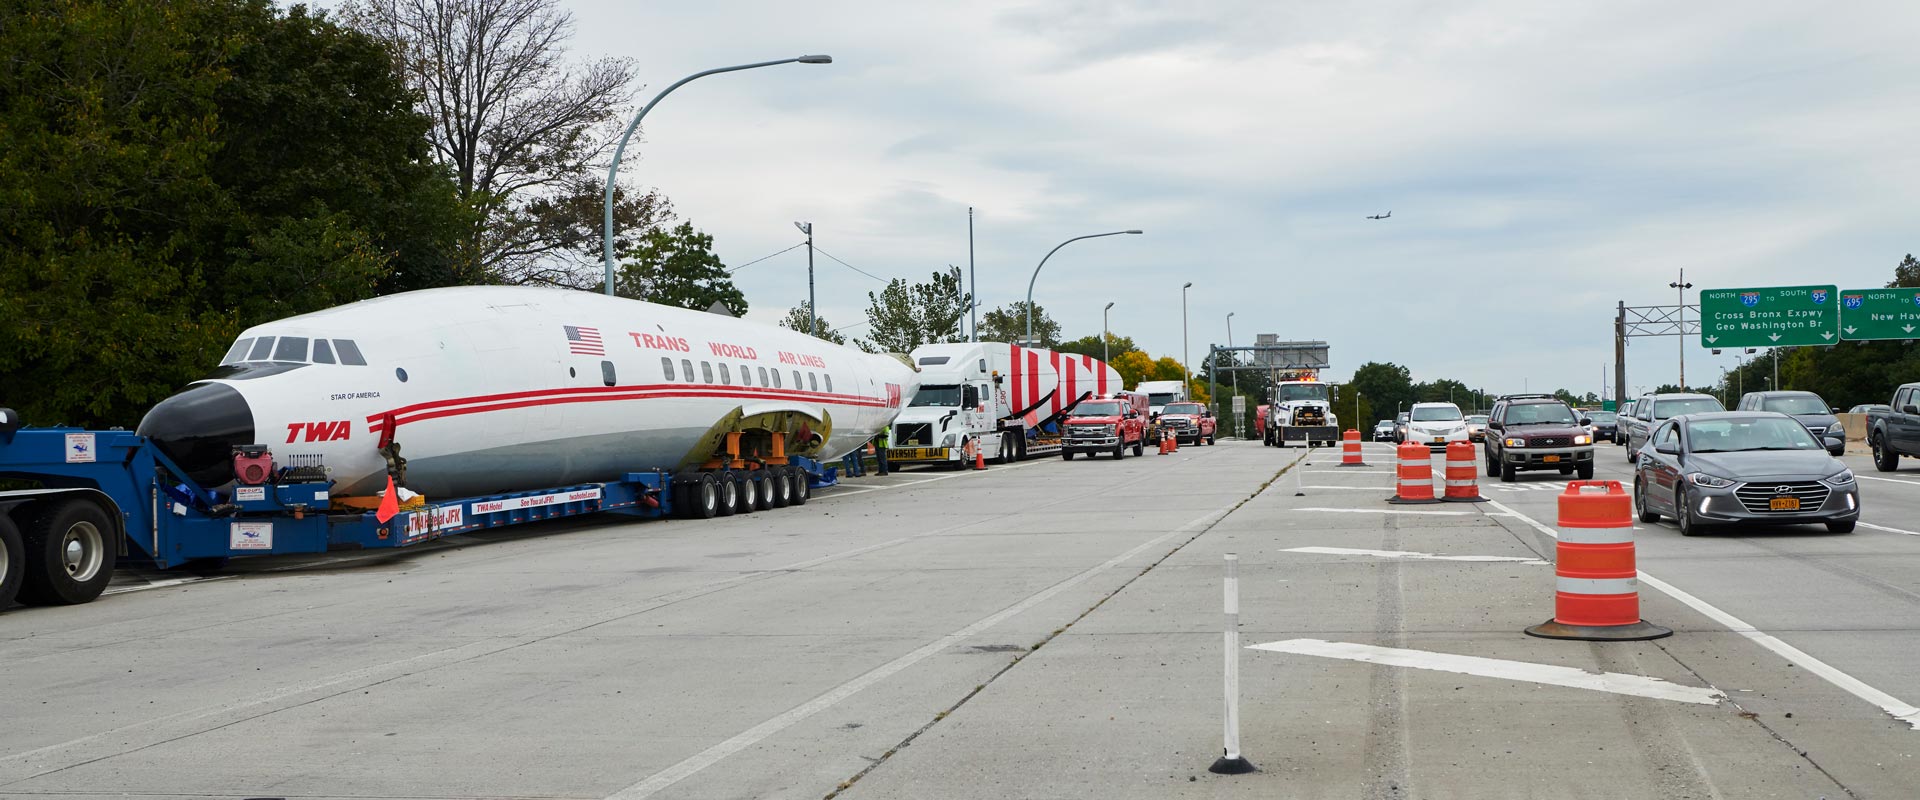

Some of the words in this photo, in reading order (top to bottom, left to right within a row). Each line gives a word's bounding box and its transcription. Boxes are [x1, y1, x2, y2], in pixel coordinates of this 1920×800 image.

[1744, 295, 1758, 304] 295
[1812, 293, 1826, 302] 95
[1846, 298, 1861, 307] 695
[1715, 312, 1744, 320] Cross
[1750, 310, 1782, 319] Bronx
[1788, 309, 1823, 318] Expwy
[1871, 313, 1894, 321] New
[1716, 323, 1735, 331] Geo
[1741, 321, 1804, 331] Washington
[1810, 320, 1822, 328] Br
[629, 332, 690, 353] TRANS
[708, 342, 757, 360] WORLD
[778, 351, 798, 365] AIR
[797, 353, 826, 369] LINES
[330, 393, 347, 401] STAR
[347, 392, 355, 400] OF
[356, 391, 381, 399] AMERICA
[286, 420, 351, 444] TWA
[886, 448, 918, 459] OVERSIZE
[925, 447, 943, 458] LOAD
[476, 503, 489, 513] TWA
[489, 501, 503, 511] Hotel
[520, 499, 530, 507] See
[530, 497, 539, 505] You
[569, 491, 597, 500] twahotel.com
[445, 508, 461, 525] JFK
